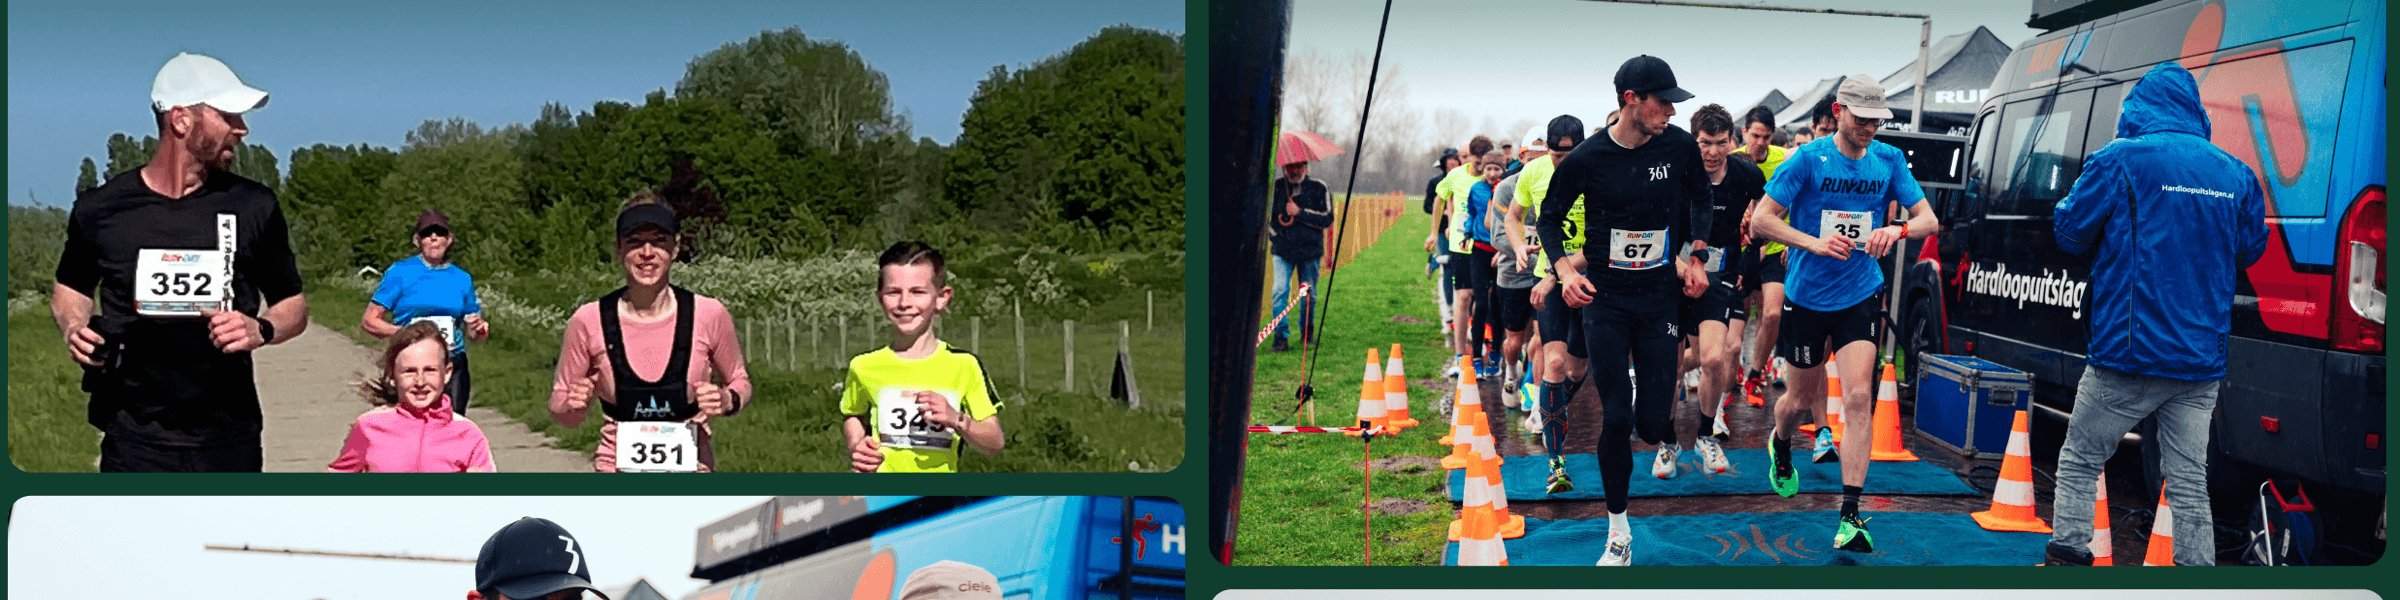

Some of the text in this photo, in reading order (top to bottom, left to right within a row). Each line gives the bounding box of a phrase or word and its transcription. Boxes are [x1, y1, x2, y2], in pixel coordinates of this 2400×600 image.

[2161, 184, 2235, 199] Hardloopuitslagen.nl
[1834, 223, 1860, 239] 35
[1624, 243, 1652, 258] 67
[151, 272, 212, 296] 352
[1967, 261, 2088, 320] Hardloopuitslag
[631, 442, 683, 466] 351
[1162, 523, 1186, 555] H
[558, 535, 580, 572] 3
[958, 579, 992, 594] ciele
